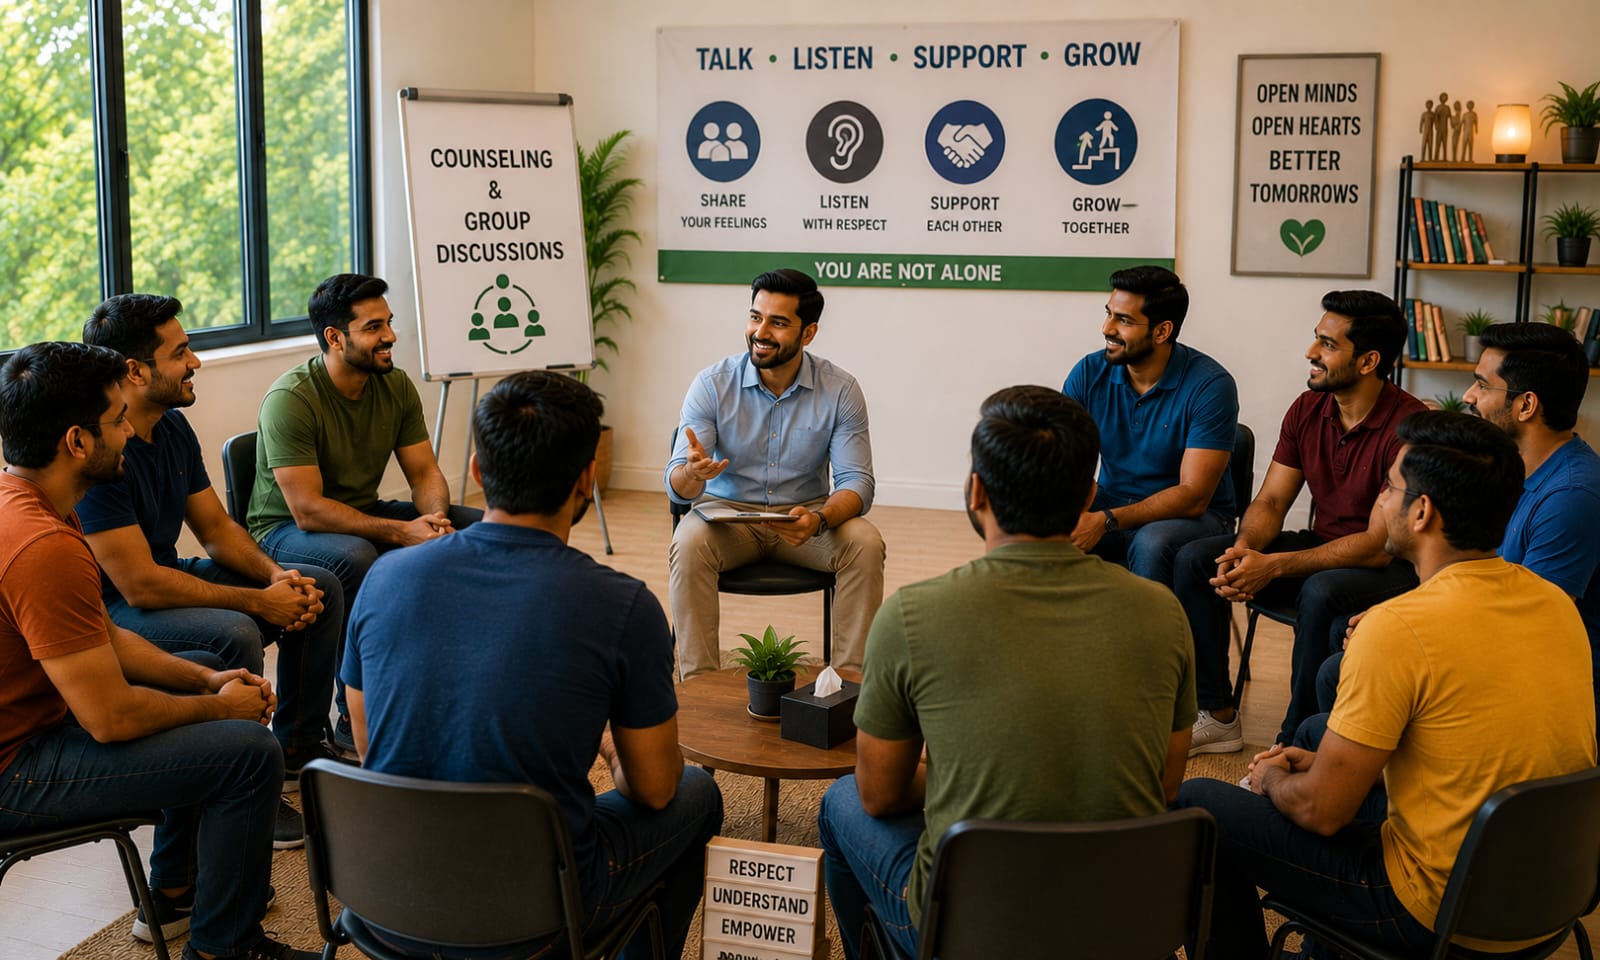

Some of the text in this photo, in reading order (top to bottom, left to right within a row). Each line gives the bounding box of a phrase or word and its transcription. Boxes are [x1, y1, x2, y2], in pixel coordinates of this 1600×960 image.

[695, 41, 1141, 71] TALK LISTEN SUPPORT GROW
[1257, 82, 1358, 103] OPEN MINDS
[1252, 116, 1361, 136] OPEN HEARTS
[430, 148, 553, 169] COUNSELING
[1269, 150, 1341, 171] BETTER
[488, 180, 502, 200] &
[1250, 183, 1359, 204] TOMORROWS
[700, 193, 746, 208] SHARE
[820, 195, 869, 209] LISTEN
[930, 195, 1000, 211] SUPPORT
[464, 211, 531, 231] GROUP
[680, 216, 767, 229] YOUR FEELINGS
[802, 218, 887, 231] WITH RESPECT
[927, 219, 1003, 233] EACH OTHER
[1062, 221, 1130, 234] TOGETHER
[436, 241, 564, 264] DISCUSSIONS
[814, 261, 1002, 282] YOU ARE NOT ALONE
[729, 858, 795, 882] RESPECT
[712, 886, 809, 915] UNDERSTAND
[721, 918, 796, 945] EMPOWER
